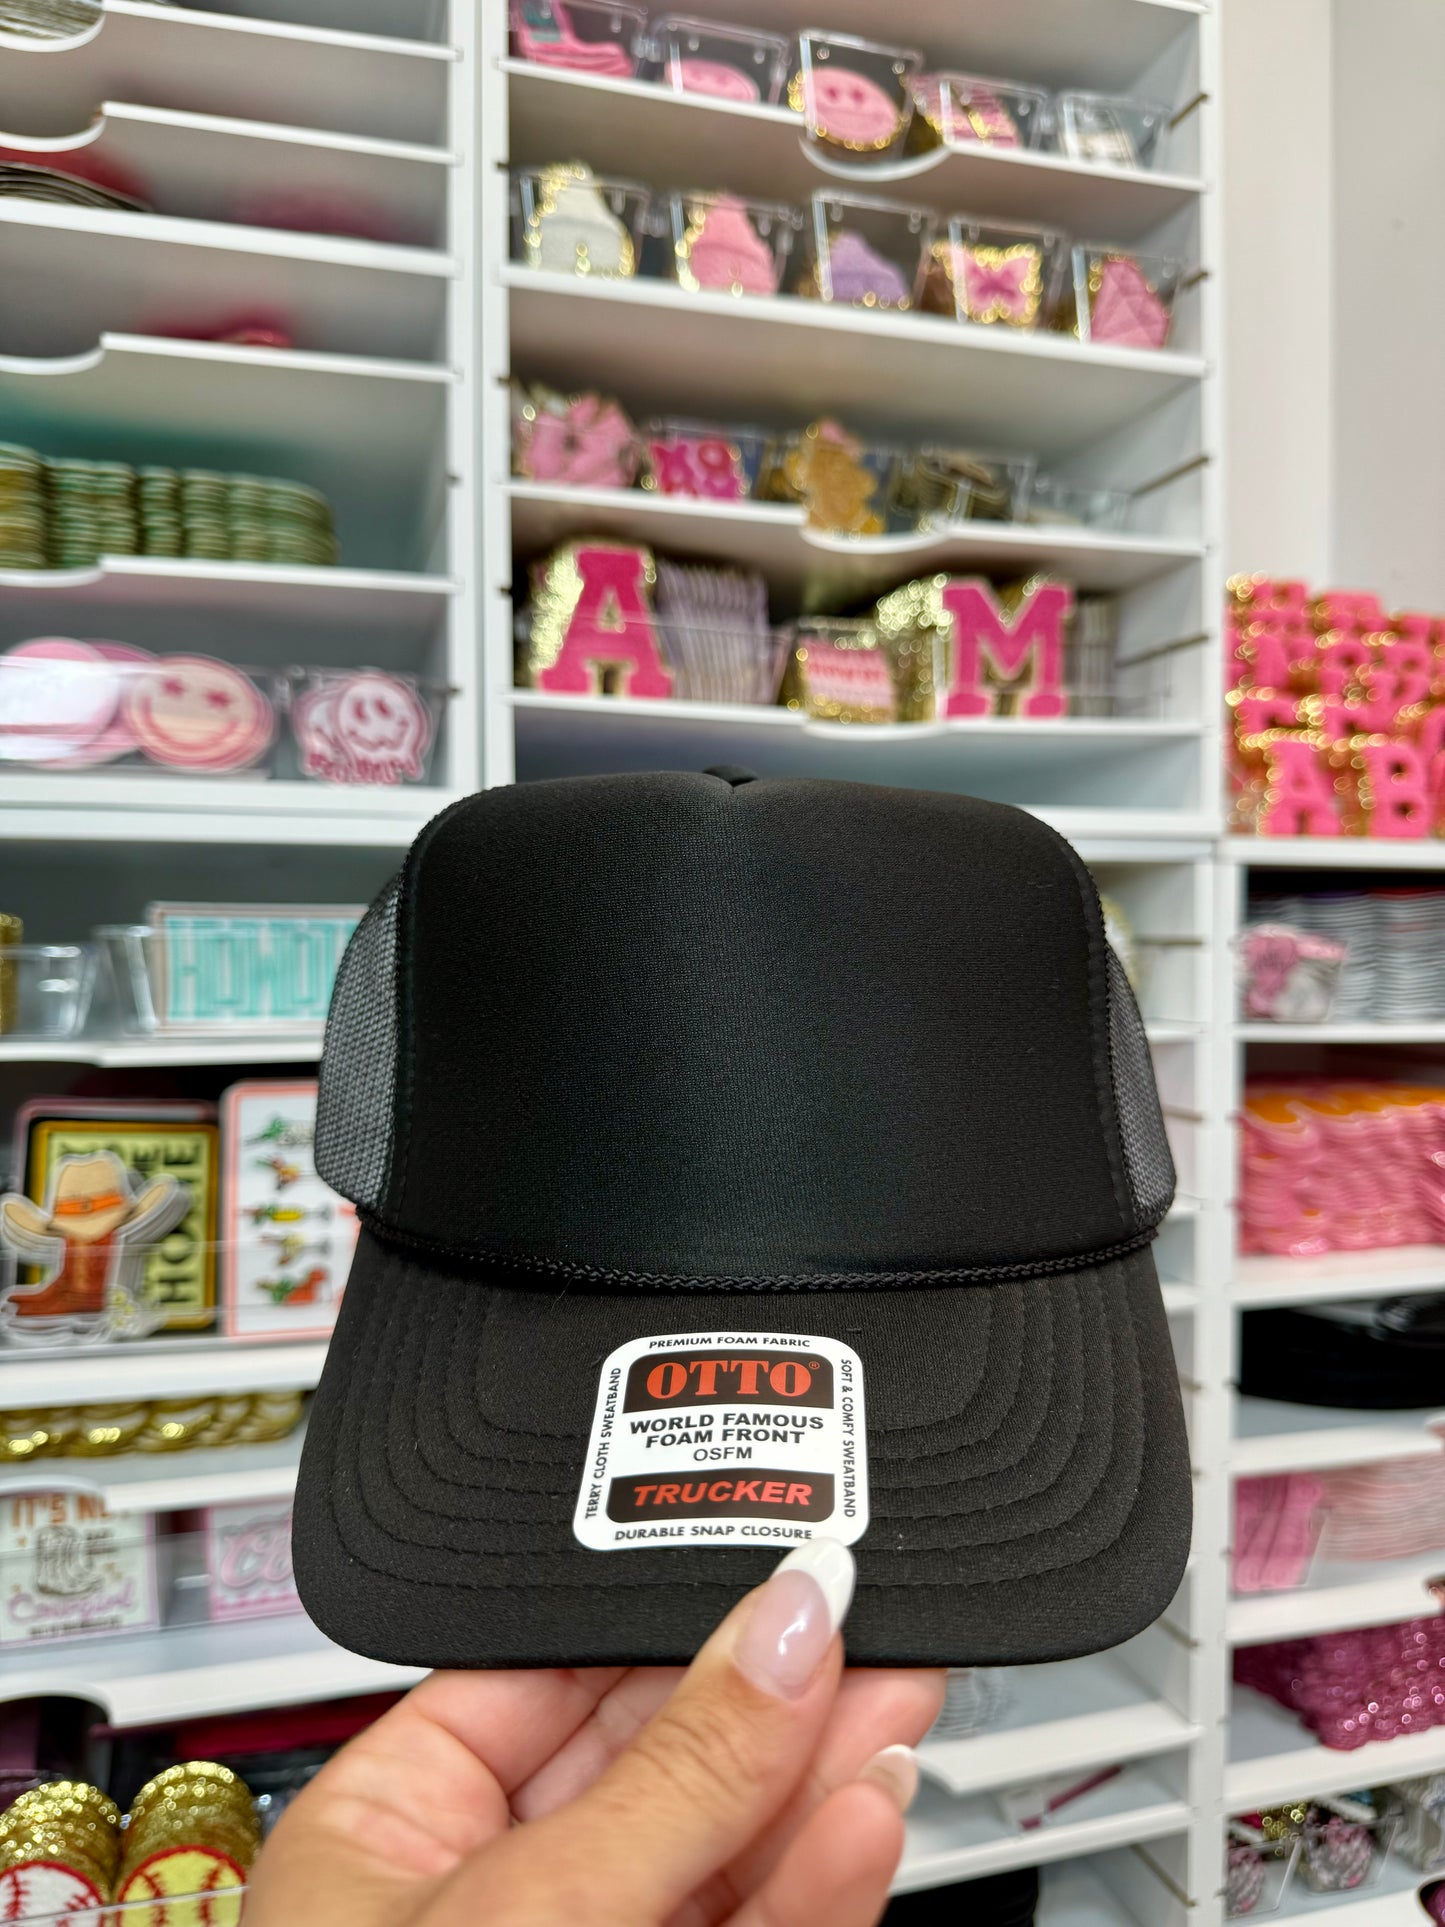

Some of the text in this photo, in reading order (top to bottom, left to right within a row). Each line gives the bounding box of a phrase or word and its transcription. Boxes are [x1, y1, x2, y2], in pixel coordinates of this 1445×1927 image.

[539, 546, 672, 698] A
[941, 581, 1073, 718] M
[649, 1336, 811, 1349] PREMIUM FOAM FABRIC
[630, 1413, 824, 1434] WORLD FAMOUS
[585, 1367, 621, 1519] TERRY CLOTH SWEATBAND
[645, 1428, 805, 1448] FOAM FRONT
[840, 1359, 856, 1518] SOFT & COMFY SWEATBAND
[693, 1446, 752, 1462] OSFM
[633, 1480, 813, 1507] TRUCKER
[614, 1525, 813, 1541] DURABLE SNAP CLOSURE
